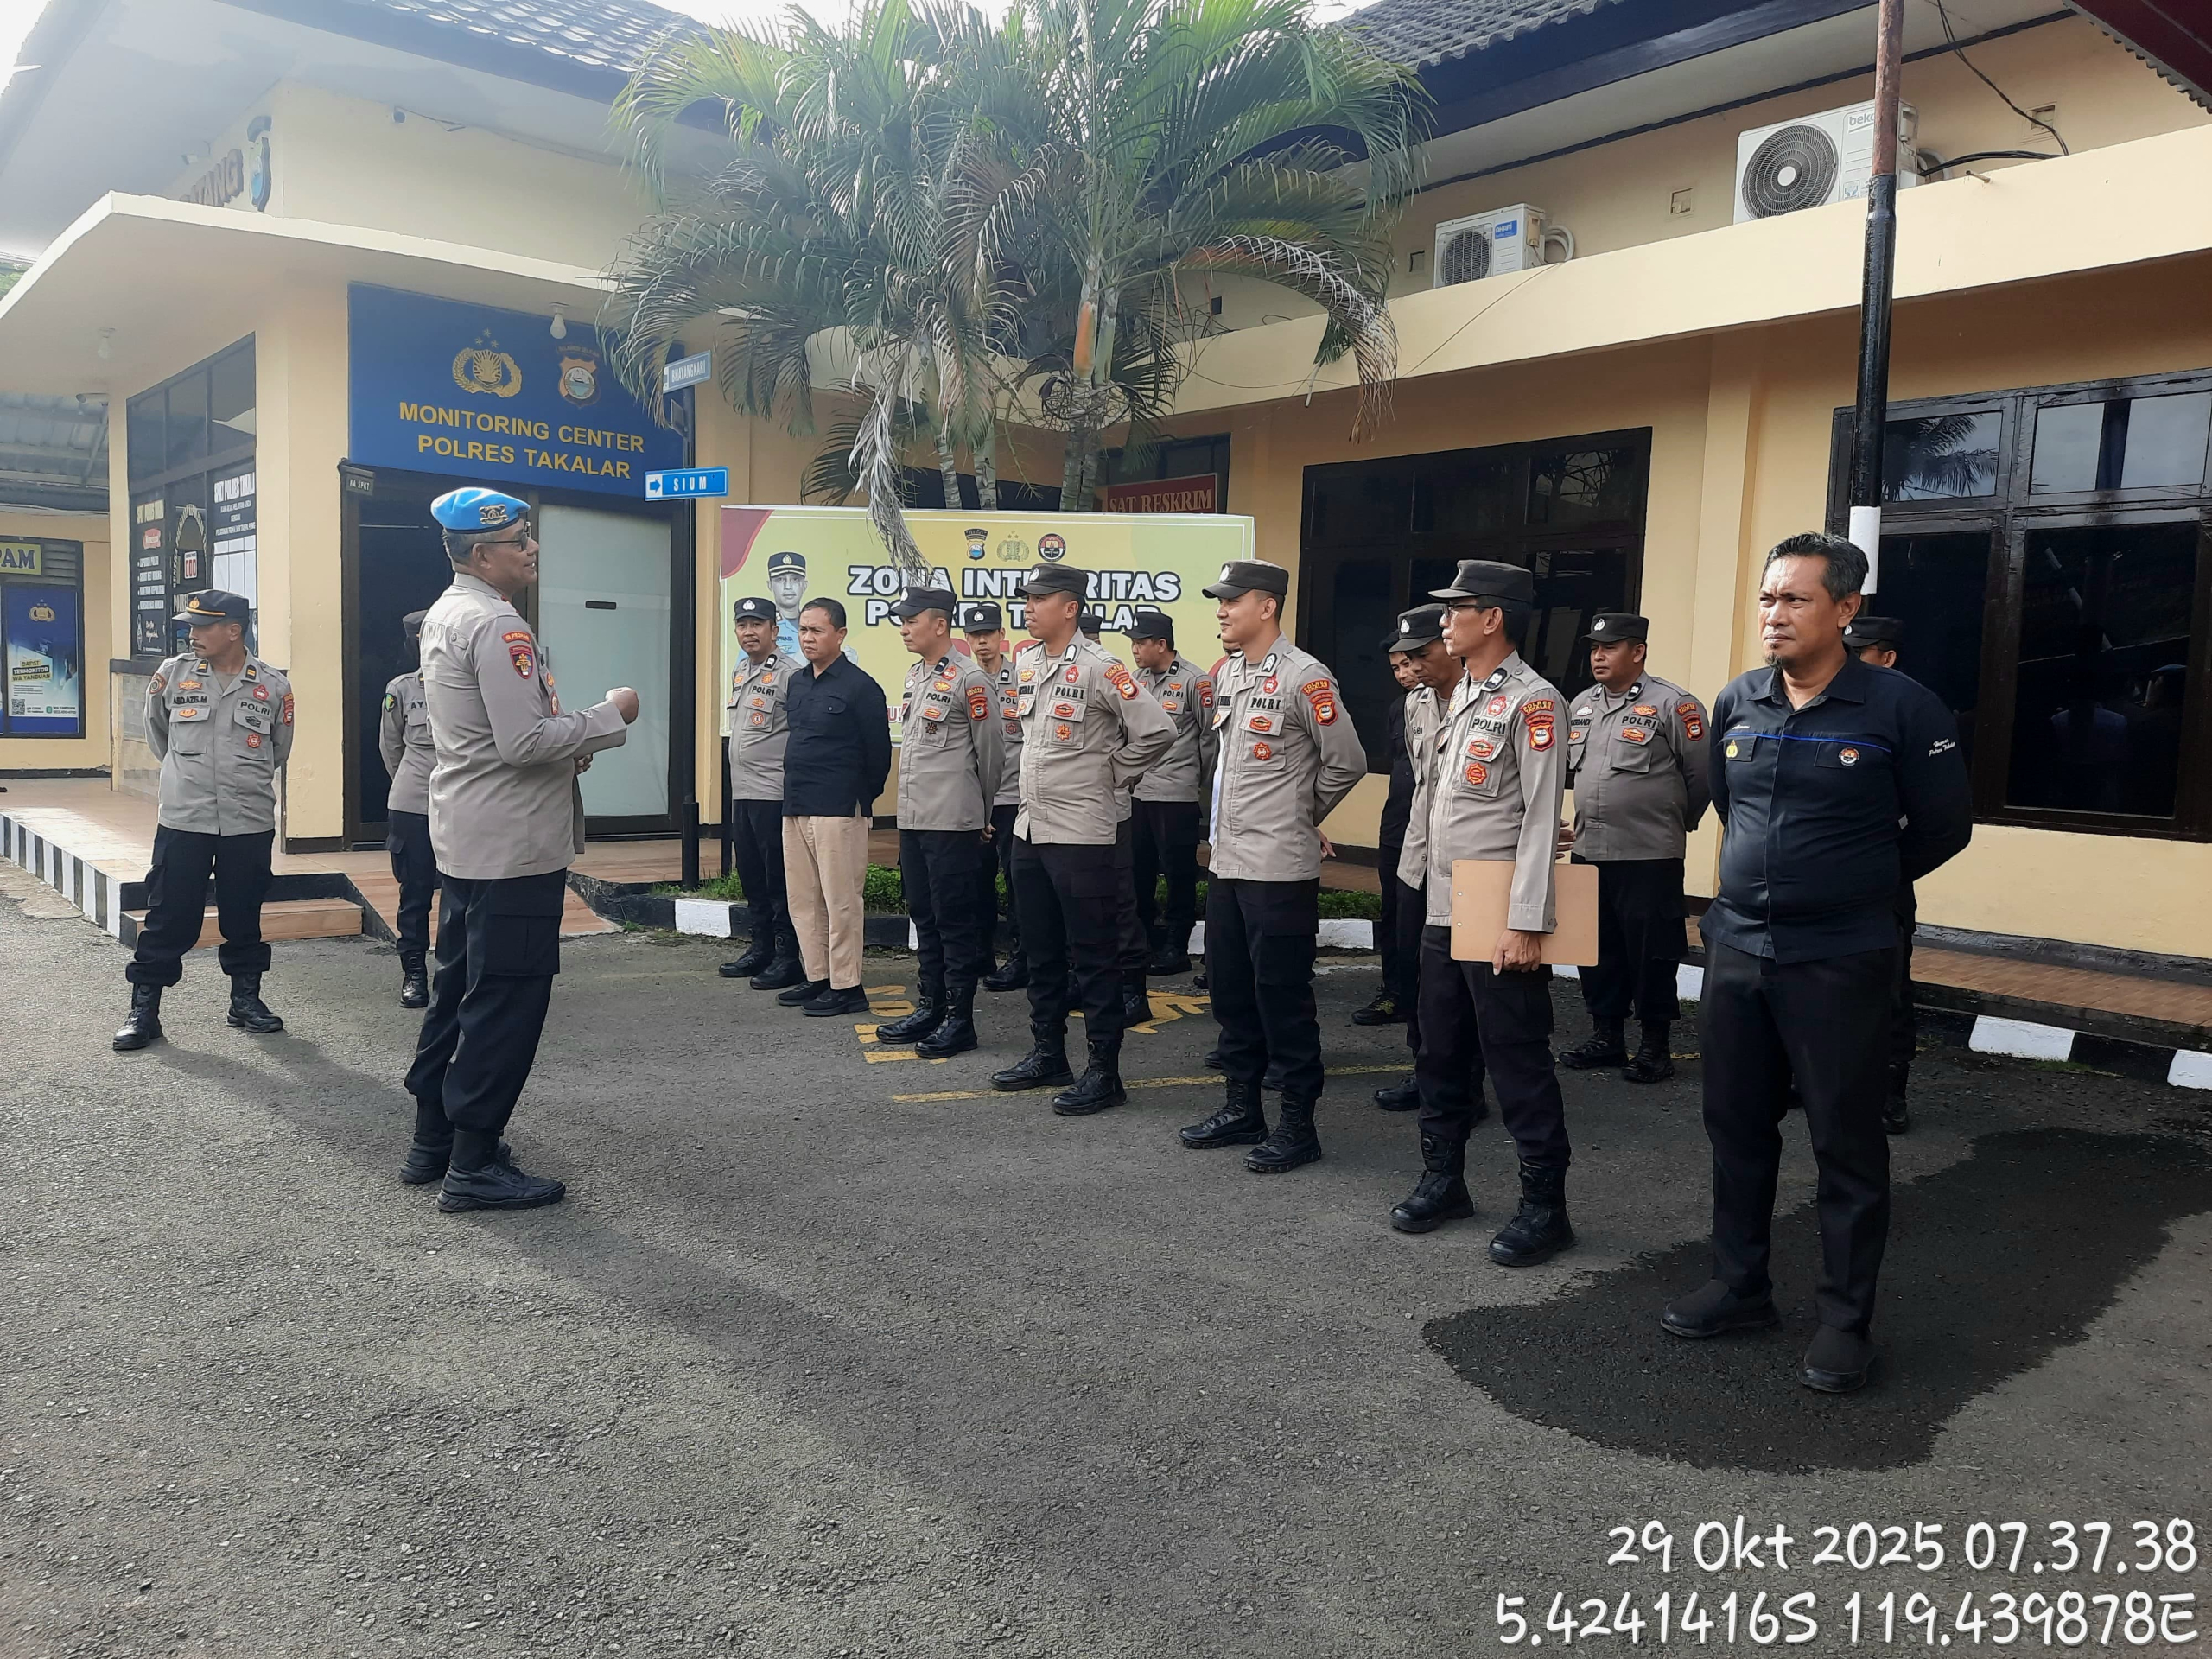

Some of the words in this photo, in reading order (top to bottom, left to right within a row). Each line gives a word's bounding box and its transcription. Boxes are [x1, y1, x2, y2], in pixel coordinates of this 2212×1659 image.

[671, 359, 706, 383] BHAYANGKARI
[399, 401, 550, 440] MONITORING
[558, 425, 645, 453] CENTER
[418, 435, 515, 464] POLRES
[524, 448, 631, 479] TAKALAR
[673, 476, 707, 492] SIUM
[1109, 496, 1136, 513] SAT
[1141, 489, 1213, 513] RESKRIM
[0, 548, 35, 569] AM
[962, 568, 1182, 603] INTRITAS
[13, 666, 49, 675] TERMONITOR
[752, 685, 775, 696] POLRI
[925, 692, 951, 703] POLRI
[1054, 686, 1084, 699] POLRI
[240, 701, 270, 715] POLRI
[410, 701, 425, 709] AY
[1250, 697, 1281, 710] POLRI
[1471, 717, 1506, 734] POLRI
[1621, 715, 1657, 728] POLRI
